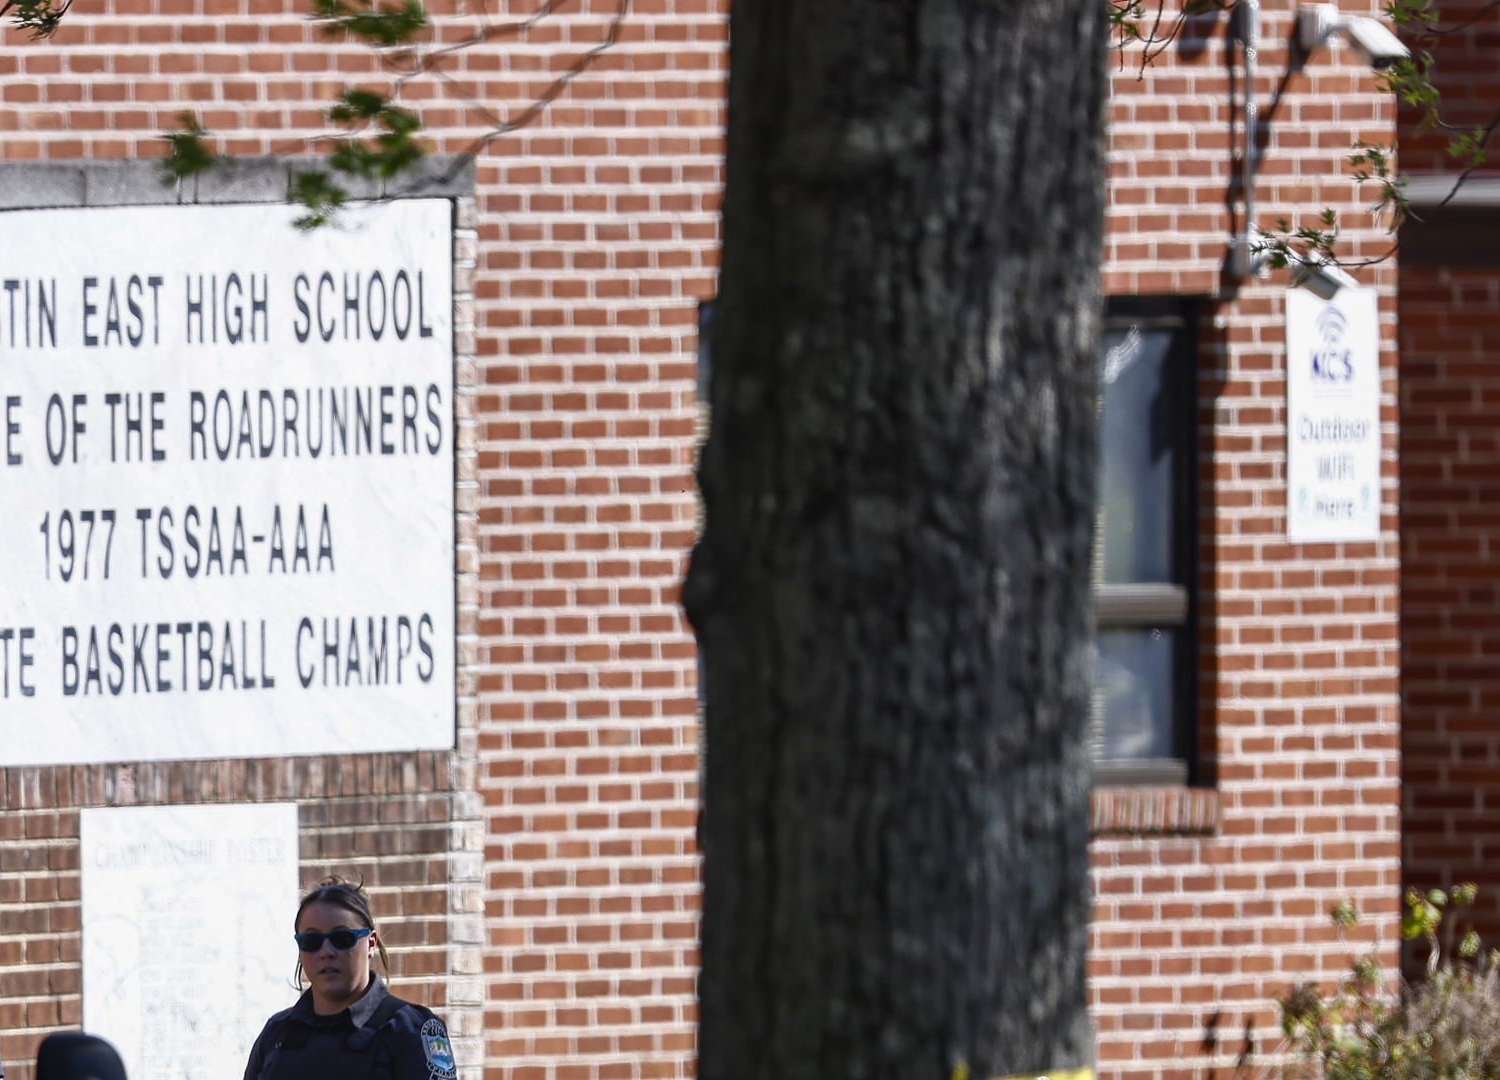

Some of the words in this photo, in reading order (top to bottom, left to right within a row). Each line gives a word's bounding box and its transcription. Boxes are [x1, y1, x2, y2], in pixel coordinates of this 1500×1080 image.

[81, 274, 164, 349] EAST
[185, 271, 270, 346] HIGH
[292, 268, 434, 344] SCHOOL
[1310, 348, 1355, 383] KCS
[44, 393, 88, 467] OF
[104, 390, 166, 463] THE
[189, 383, 443, 463] ROADRUNNERS
[39, 509, 117, 583] 1977
[134, 503, 336, 580] TSSAA-AAA
[61, 620, 276, 698] BASKETBALL
[295, 612, 435, 690] CHAMPS
